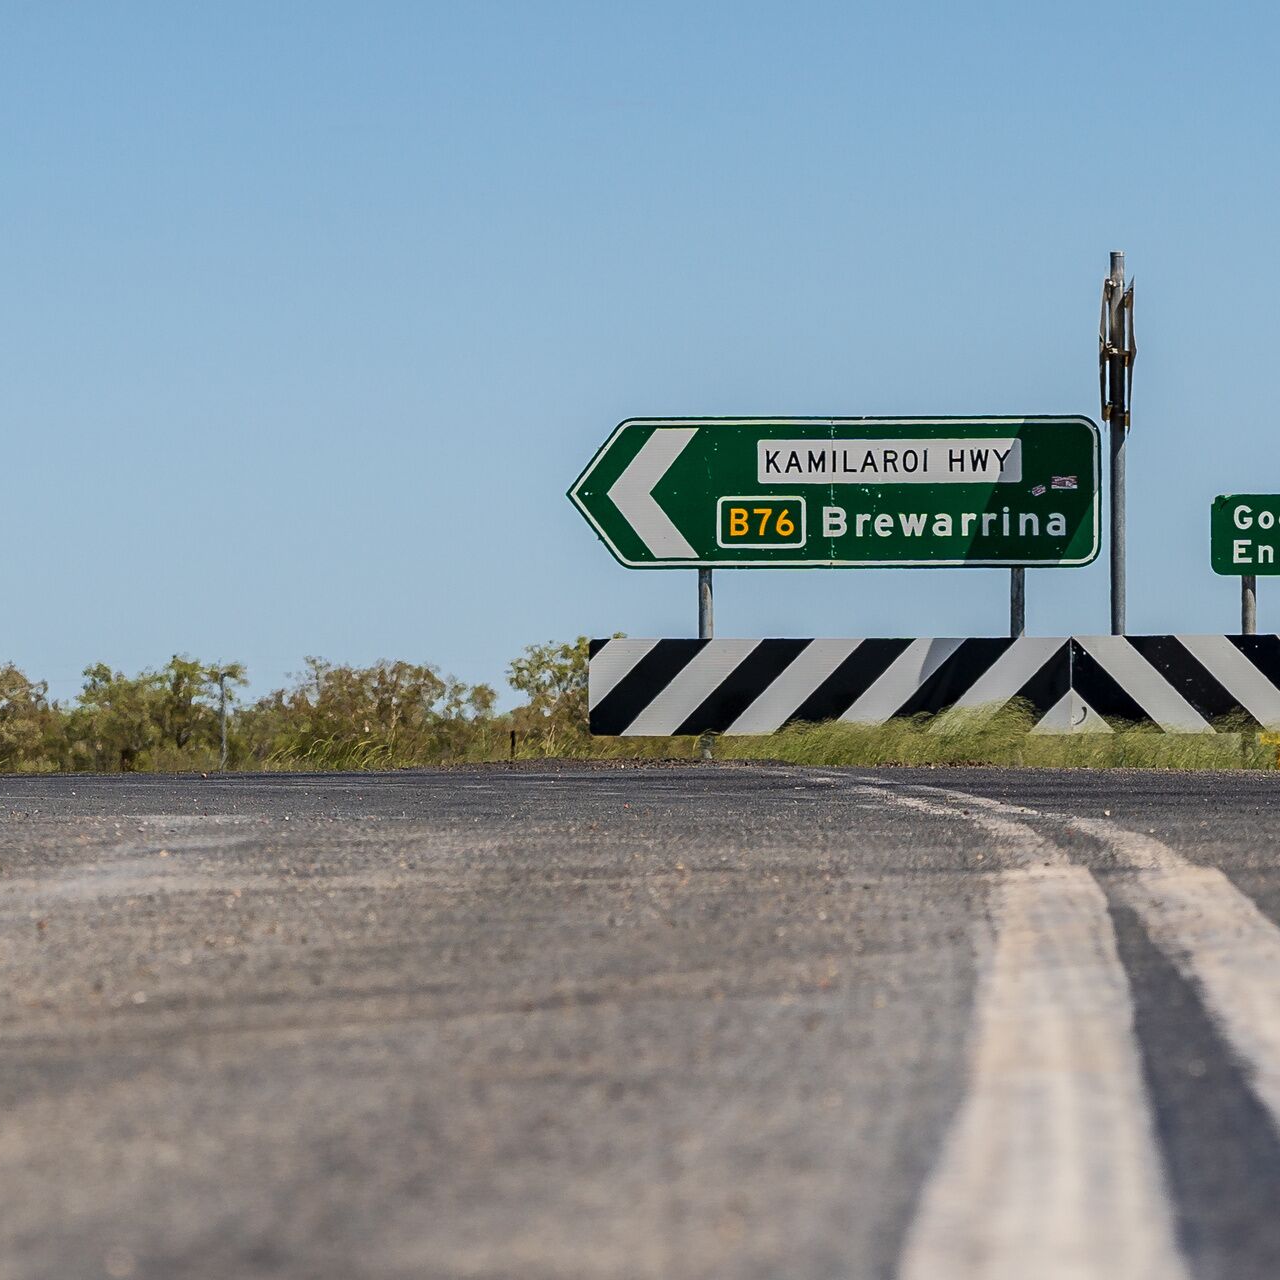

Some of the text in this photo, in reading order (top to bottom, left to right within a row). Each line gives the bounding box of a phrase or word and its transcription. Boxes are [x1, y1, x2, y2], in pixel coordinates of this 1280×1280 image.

[765, 448, 1013, 474] KAMILAROI HWY
[729, 508, 796, 537] B76
[822, 506, 1068, 538] Brewarrina
